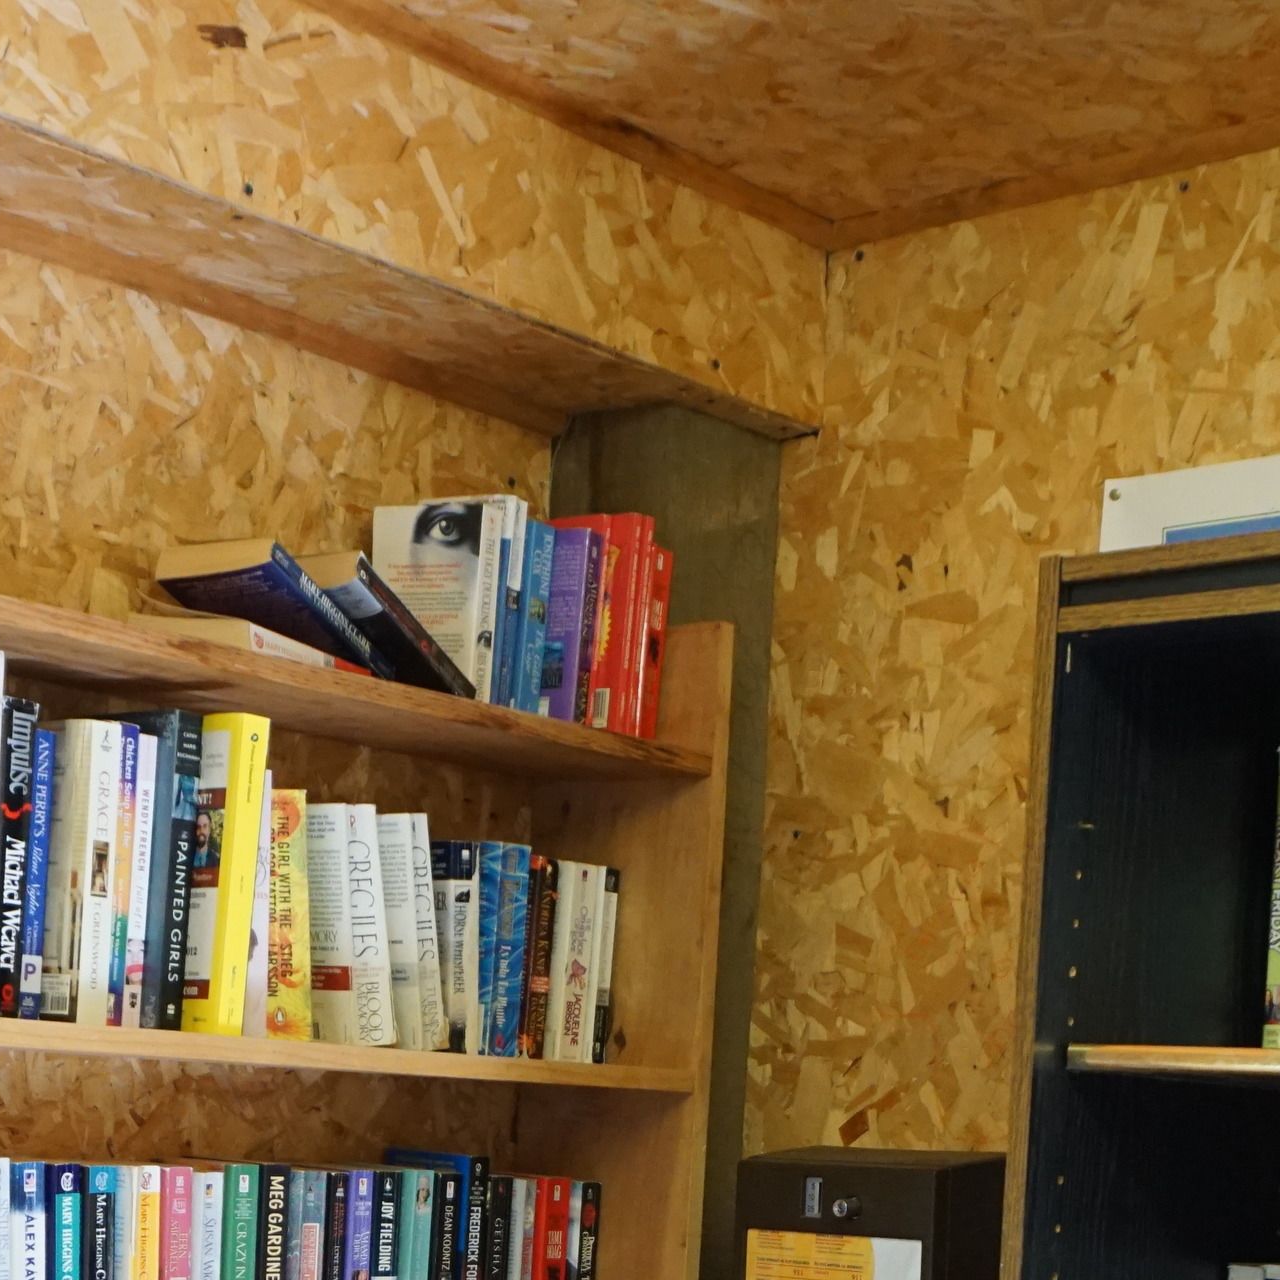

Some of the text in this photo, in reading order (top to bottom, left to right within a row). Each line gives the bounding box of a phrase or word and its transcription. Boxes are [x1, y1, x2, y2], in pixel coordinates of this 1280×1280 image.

[7, 709, 35, 796] Impulse
[32, 737, 50, 838] ANNE PERRY'S
[96, 771, 111, 837] GRACE
[137, 789, 151, 872] WENDY FRENCH
[277, 816, 292, 929] THE GIRL WITH THE
[0, 836, 26, 973] Michael Weaver
[167, 840, 189, 983] PAINTED GIRLS
[267, 943, 293, 998] STIEG LARSSON
[570, 992, 584, 1046] JACQUELINE
[62, 1197, 73, 1226] MARY
[96, 1194, 107, 1226] MARY
[269, 1175, 286, 1213] MEG
[24, 1214, 36, 1252] ALEX
[62, 1228, 73, 1270] HIGGINS
[96, 1227, 107, 1270] HIGGINS
[235, 1222, 248, 1264] CRAZY
[378, 1201, 394, 1273] JOY FIELDING
[440, 1205, 454, 1271] DEAN KOONTZ
[466, 1206, 482, 1262] FREDERICK
[234, 1266, 246, 1278] IN
